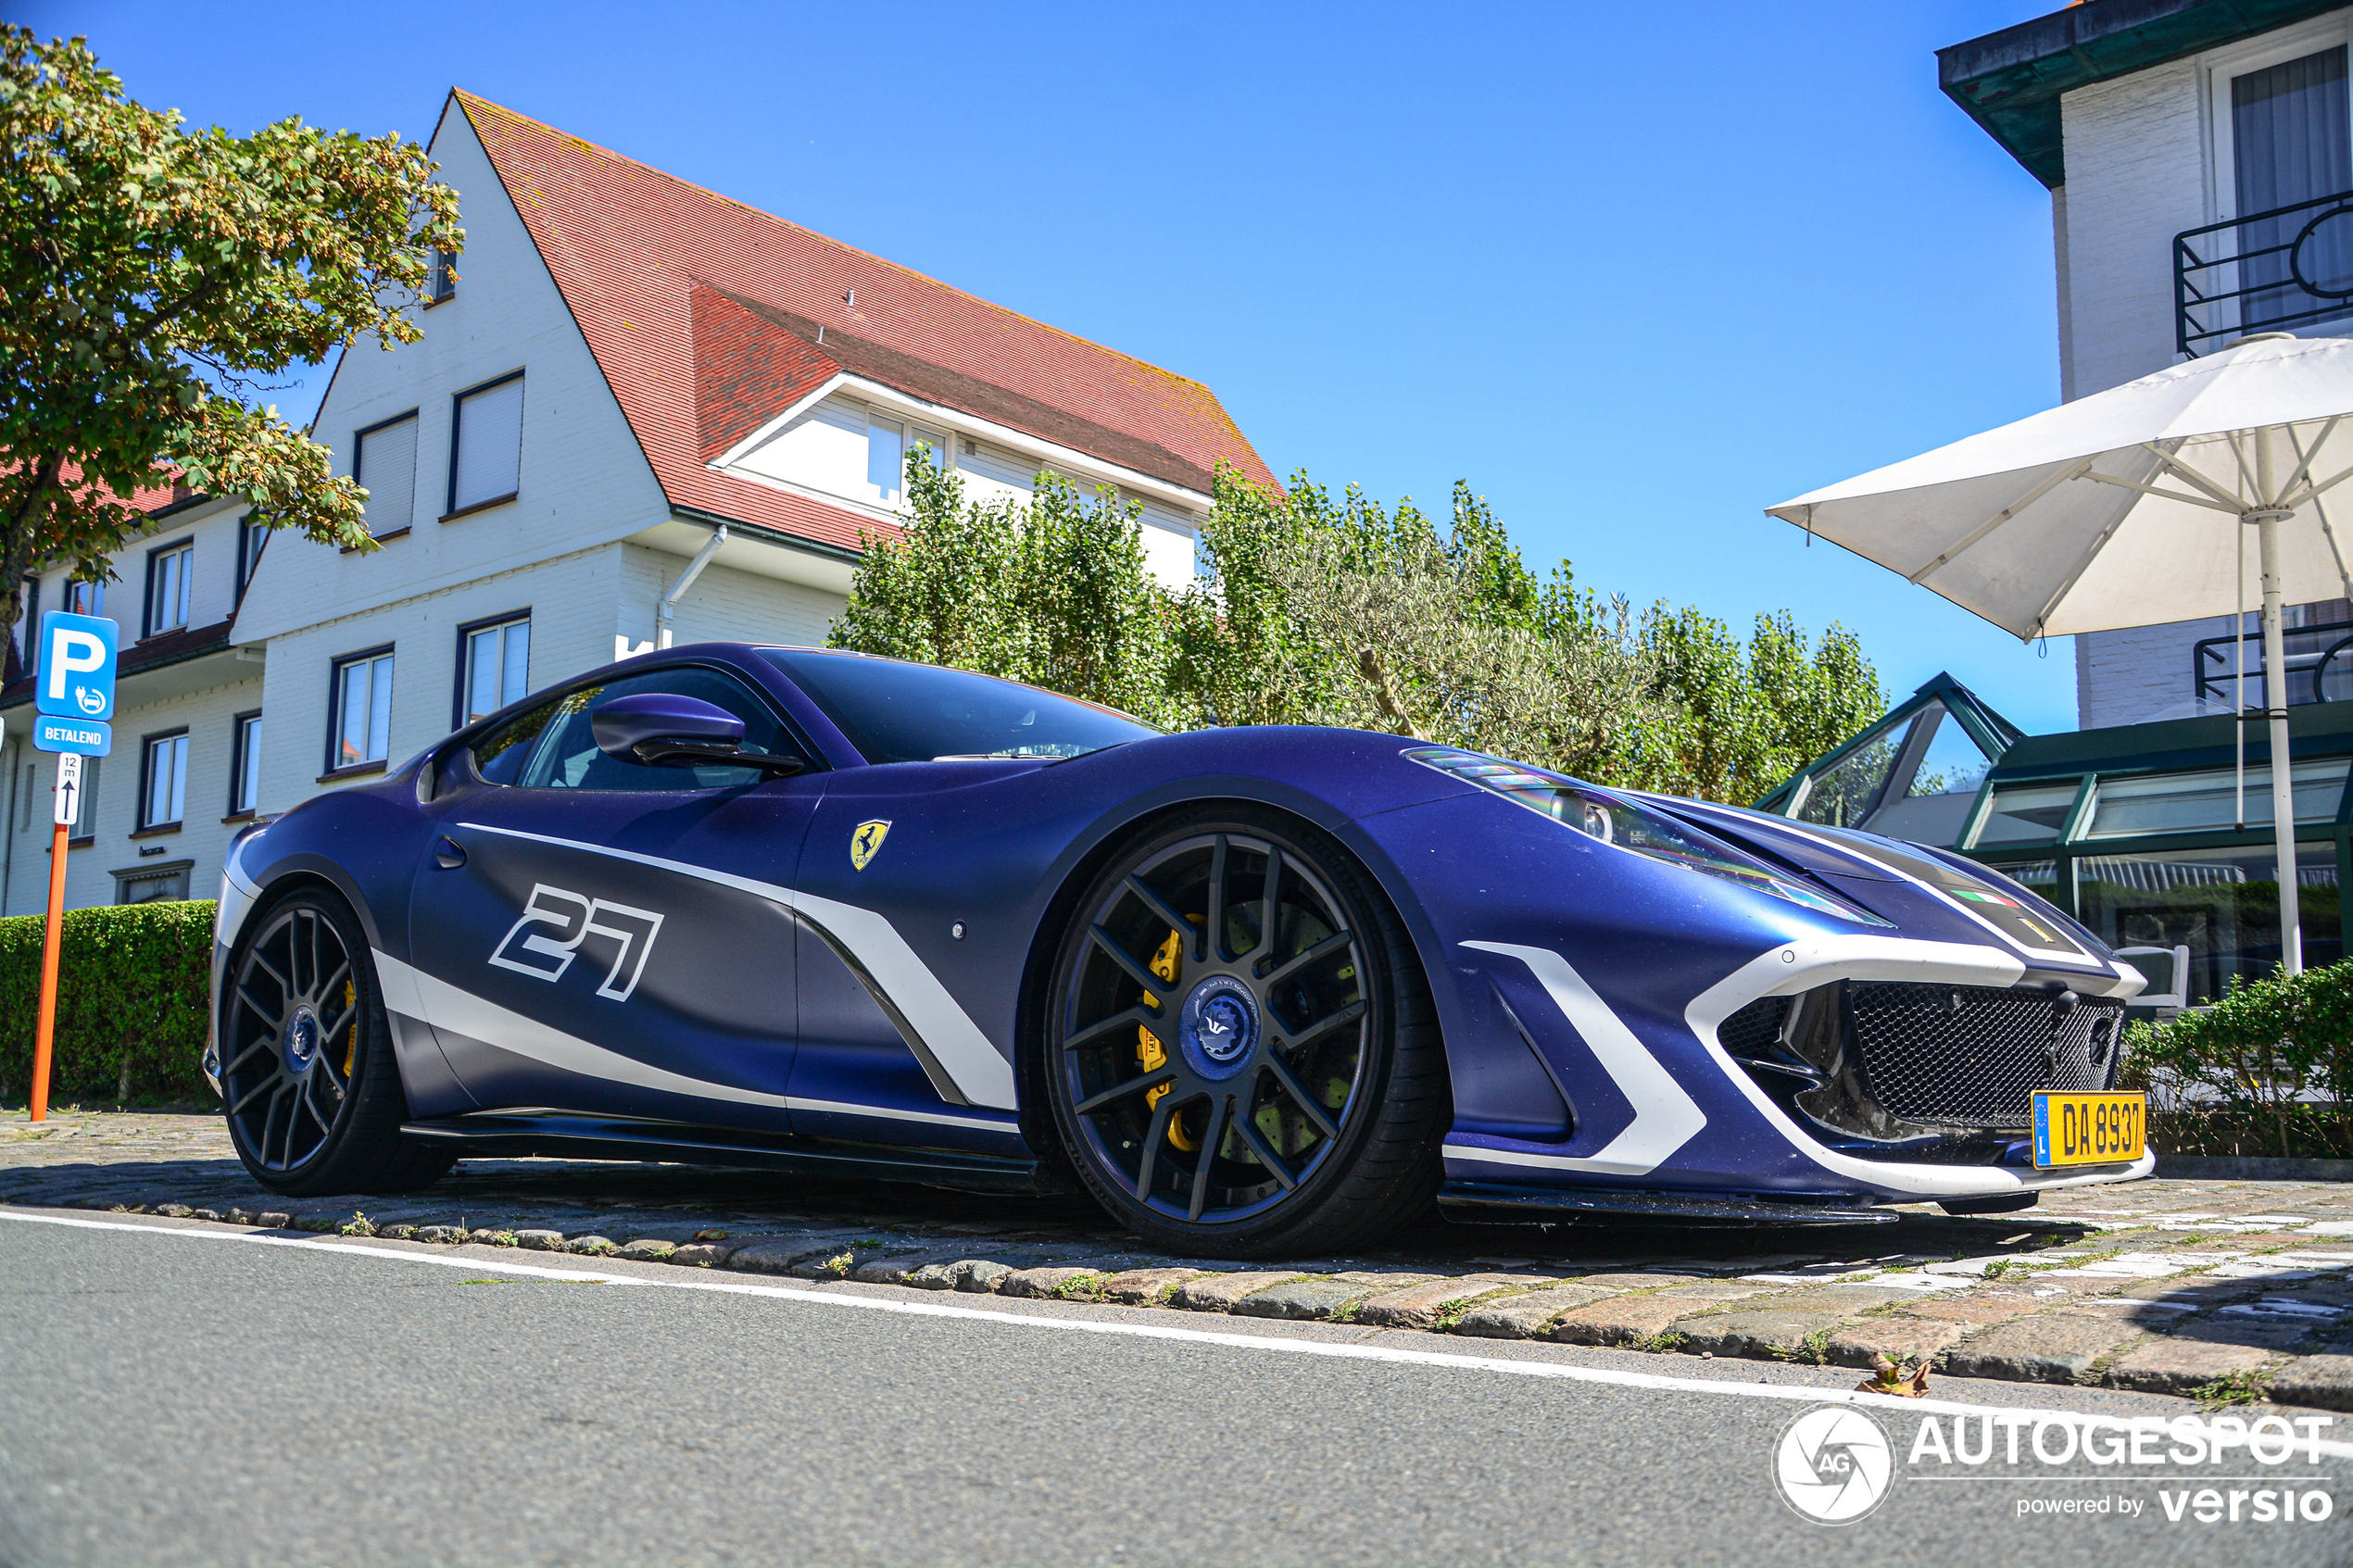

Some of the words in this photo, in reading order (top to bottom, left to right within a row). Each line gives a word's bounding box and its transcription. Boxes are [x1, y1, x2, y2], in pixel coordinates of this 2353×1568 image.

[49, 628, 106, 699] P
[44, 726, 102, 746] BETALEND
[65, 757, 76, 767] 12
[64, 770, 75, 778] m
[488, 883, 664, 1002] 27
[2064, 1103, 2090, 1156] DA
[2096, 1102, 2139, 1154] 8937
[2039, 1135, 2046, 1154] L
